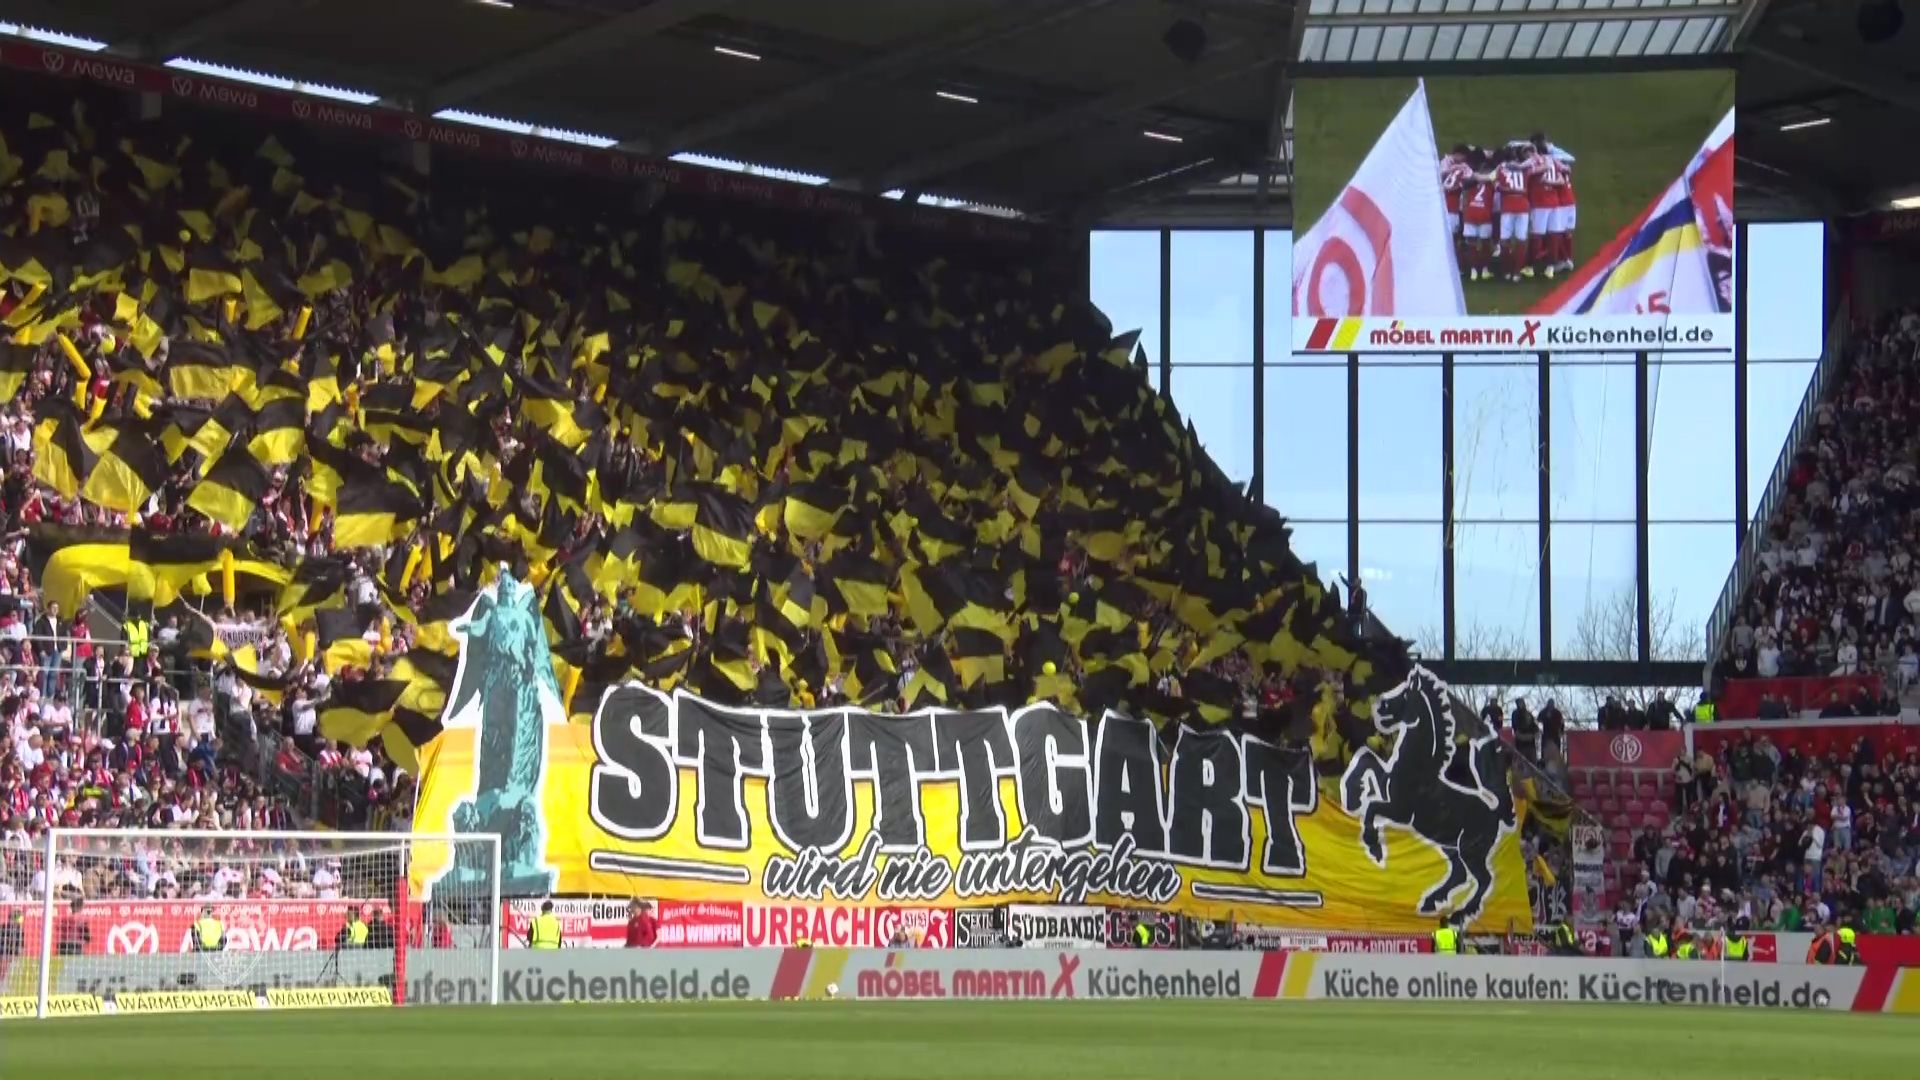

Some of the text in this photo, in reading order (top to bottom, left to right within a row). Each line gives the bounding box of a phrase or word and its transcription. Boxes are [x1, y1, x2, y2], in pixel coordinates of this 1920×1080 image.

[1370, 320, 1435, 344] MÖBEL
[1440, 329, 1513, 345] MARTIN
[1547, 326, 1713, 344] Küchenheld.de
[590, 681, 1316, 875] STUTTGART
[763, 825, 1181, 903] wird nie untergehen
[661, 923, 742, 943] BAD WIMPFEN
[747, 907, 871, 946] URBACH
[1011, 913, 1104, 944] SÜDBANDE
[503, 967, 750, 1001] Küchenheld.de
[952, 970, 1046, 998] MARTIN
[1088, 966, 1241, 998] Küchenheld
[1324, 969, 1831, 1008] Küche online kaufen: Küchenheld.de
